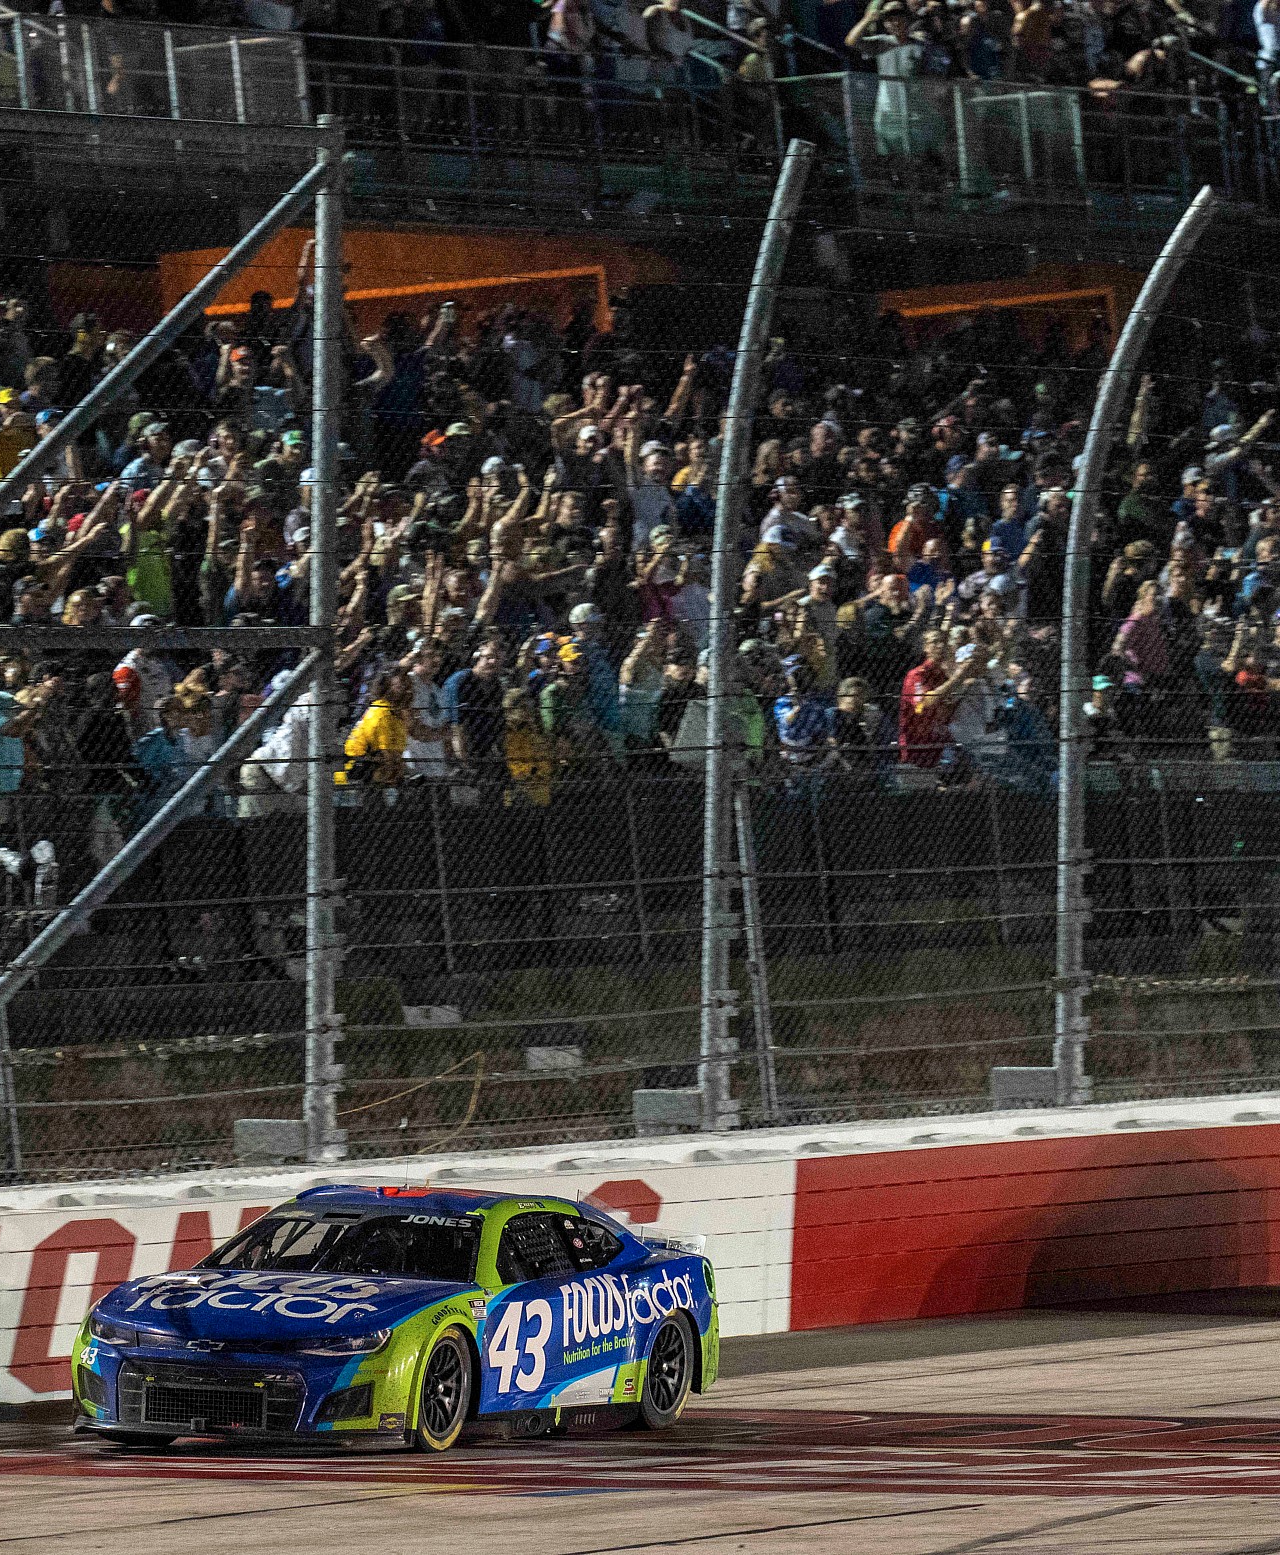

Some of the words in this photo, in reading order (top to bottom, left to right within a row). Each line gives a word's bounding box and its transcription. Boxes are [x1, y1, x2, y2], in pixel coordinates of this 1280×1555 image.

[400, 1214, 473, 1228] JONES
[80, 1346, 99, 1365] 43
[488, 1299, 553, 1395] 43
[563, 1349, 591, 1366] Nutrition
[591, 1341, 601, 1355] for
[602, 1337, 613, 1351] the
